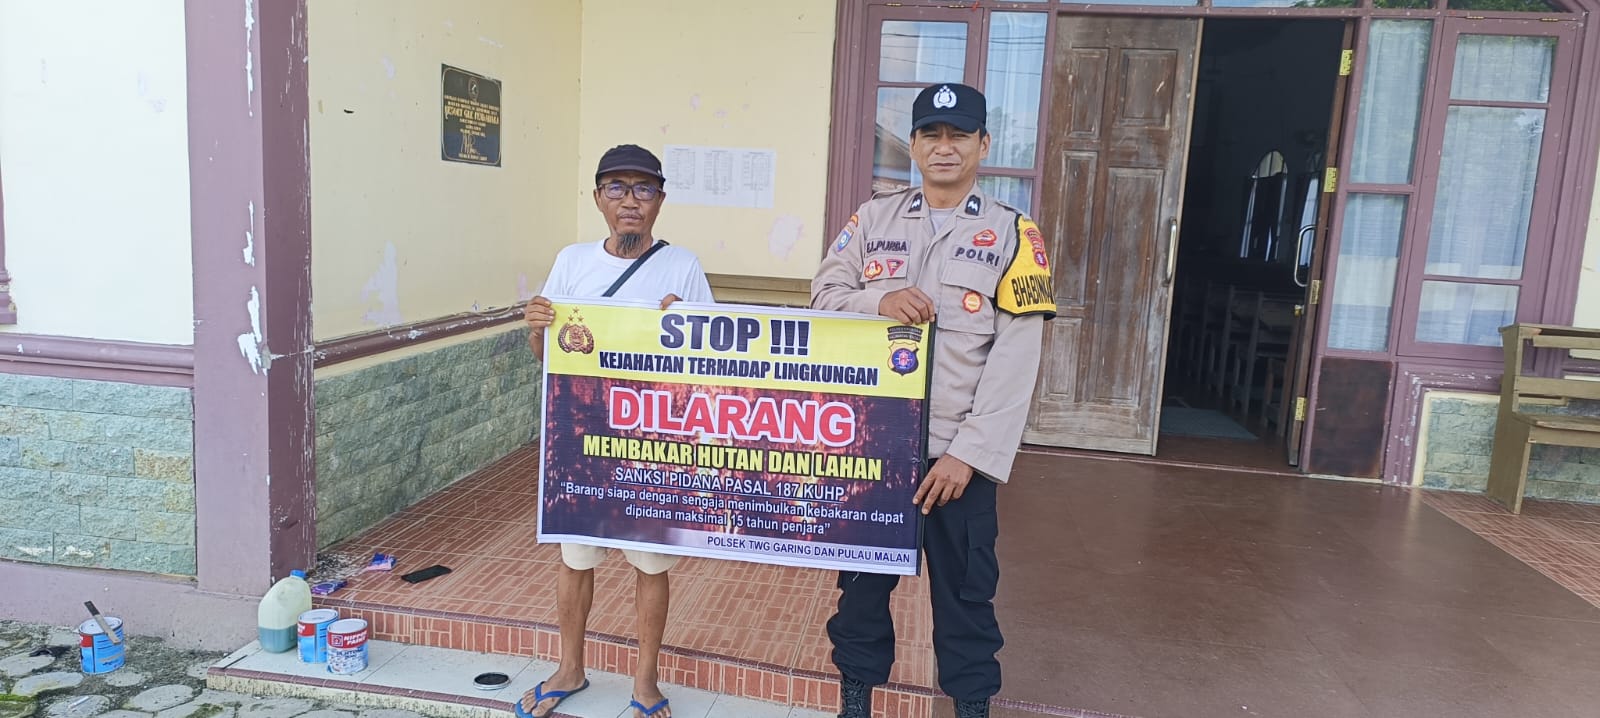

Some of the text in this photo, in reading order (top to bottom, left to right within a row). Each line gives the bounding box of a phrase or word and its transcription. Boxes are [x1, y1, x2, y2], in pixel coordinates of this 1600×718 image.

[955, 247, 1000, 266] POLRI
[660, 313, 810, 356] STOP !!!
[600, 352, 878, 386] KEJAHATAN TERHADAP LINGKUNGAN
[609, 386, 855, 447] DILARANG
[583, 434, 882, 481] MEMBAKAR HUTAN DAN LAHAN
[615, 467, 845, 500] SANKSI PIDANA PASAL 187 KUHP
[607, 486, 635, 501] siapa
[639, 489, 679, 505] dengan
[682, 494, 724, 510] sengaja
[728, 500, 804, 516] menimbulkan
[807, 506, 867, 521] kebakaran
[870, 510, 904, 526] dapat
[625, 504, 672, 520] dipidana
[675, 510, 727, 526] maksimal
[730, 515, 744, 528] 15
[746, 517, 778, 531] tahun
[707, 536, 910, 564] POLSEK TWG GARING DAN PULAU MALAN
